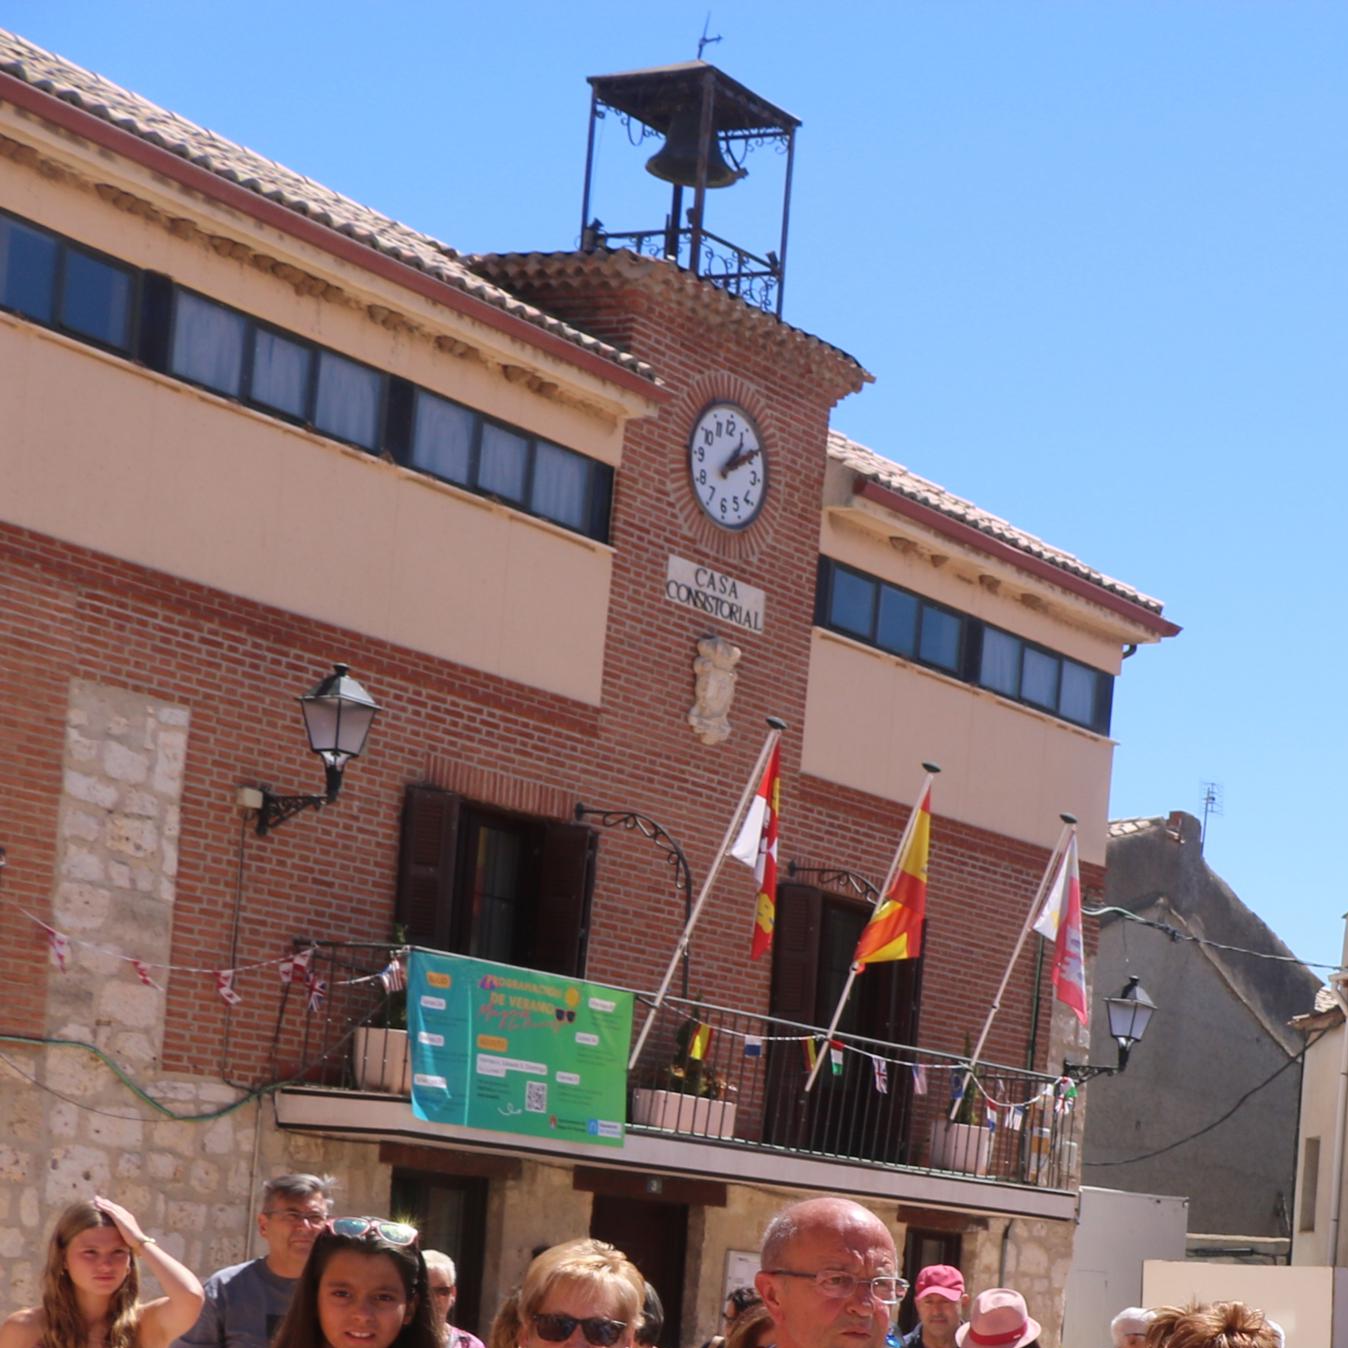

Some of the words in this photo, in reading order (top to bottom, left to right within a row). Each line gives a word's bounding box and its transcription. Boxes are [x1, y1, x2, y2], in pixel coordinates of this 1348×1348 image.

[716, 421, 722, 438] 11
[726, 419, 736, 437] 12
[704, 428, 713, 446] 10
[697, 446, 704, 462] 9
[700, 469, 706, 485] 8
[750, 470, 757, 486] 3
[709, 485, 715, 501] 7
[743, 489, 750, 504] 4
[720, 498, 727, 513] 6
[733, 496, 739, 512] 5
[695, 567, 738, 600] CASA
[665, 580, 763, 631] CONSISTORIAL
